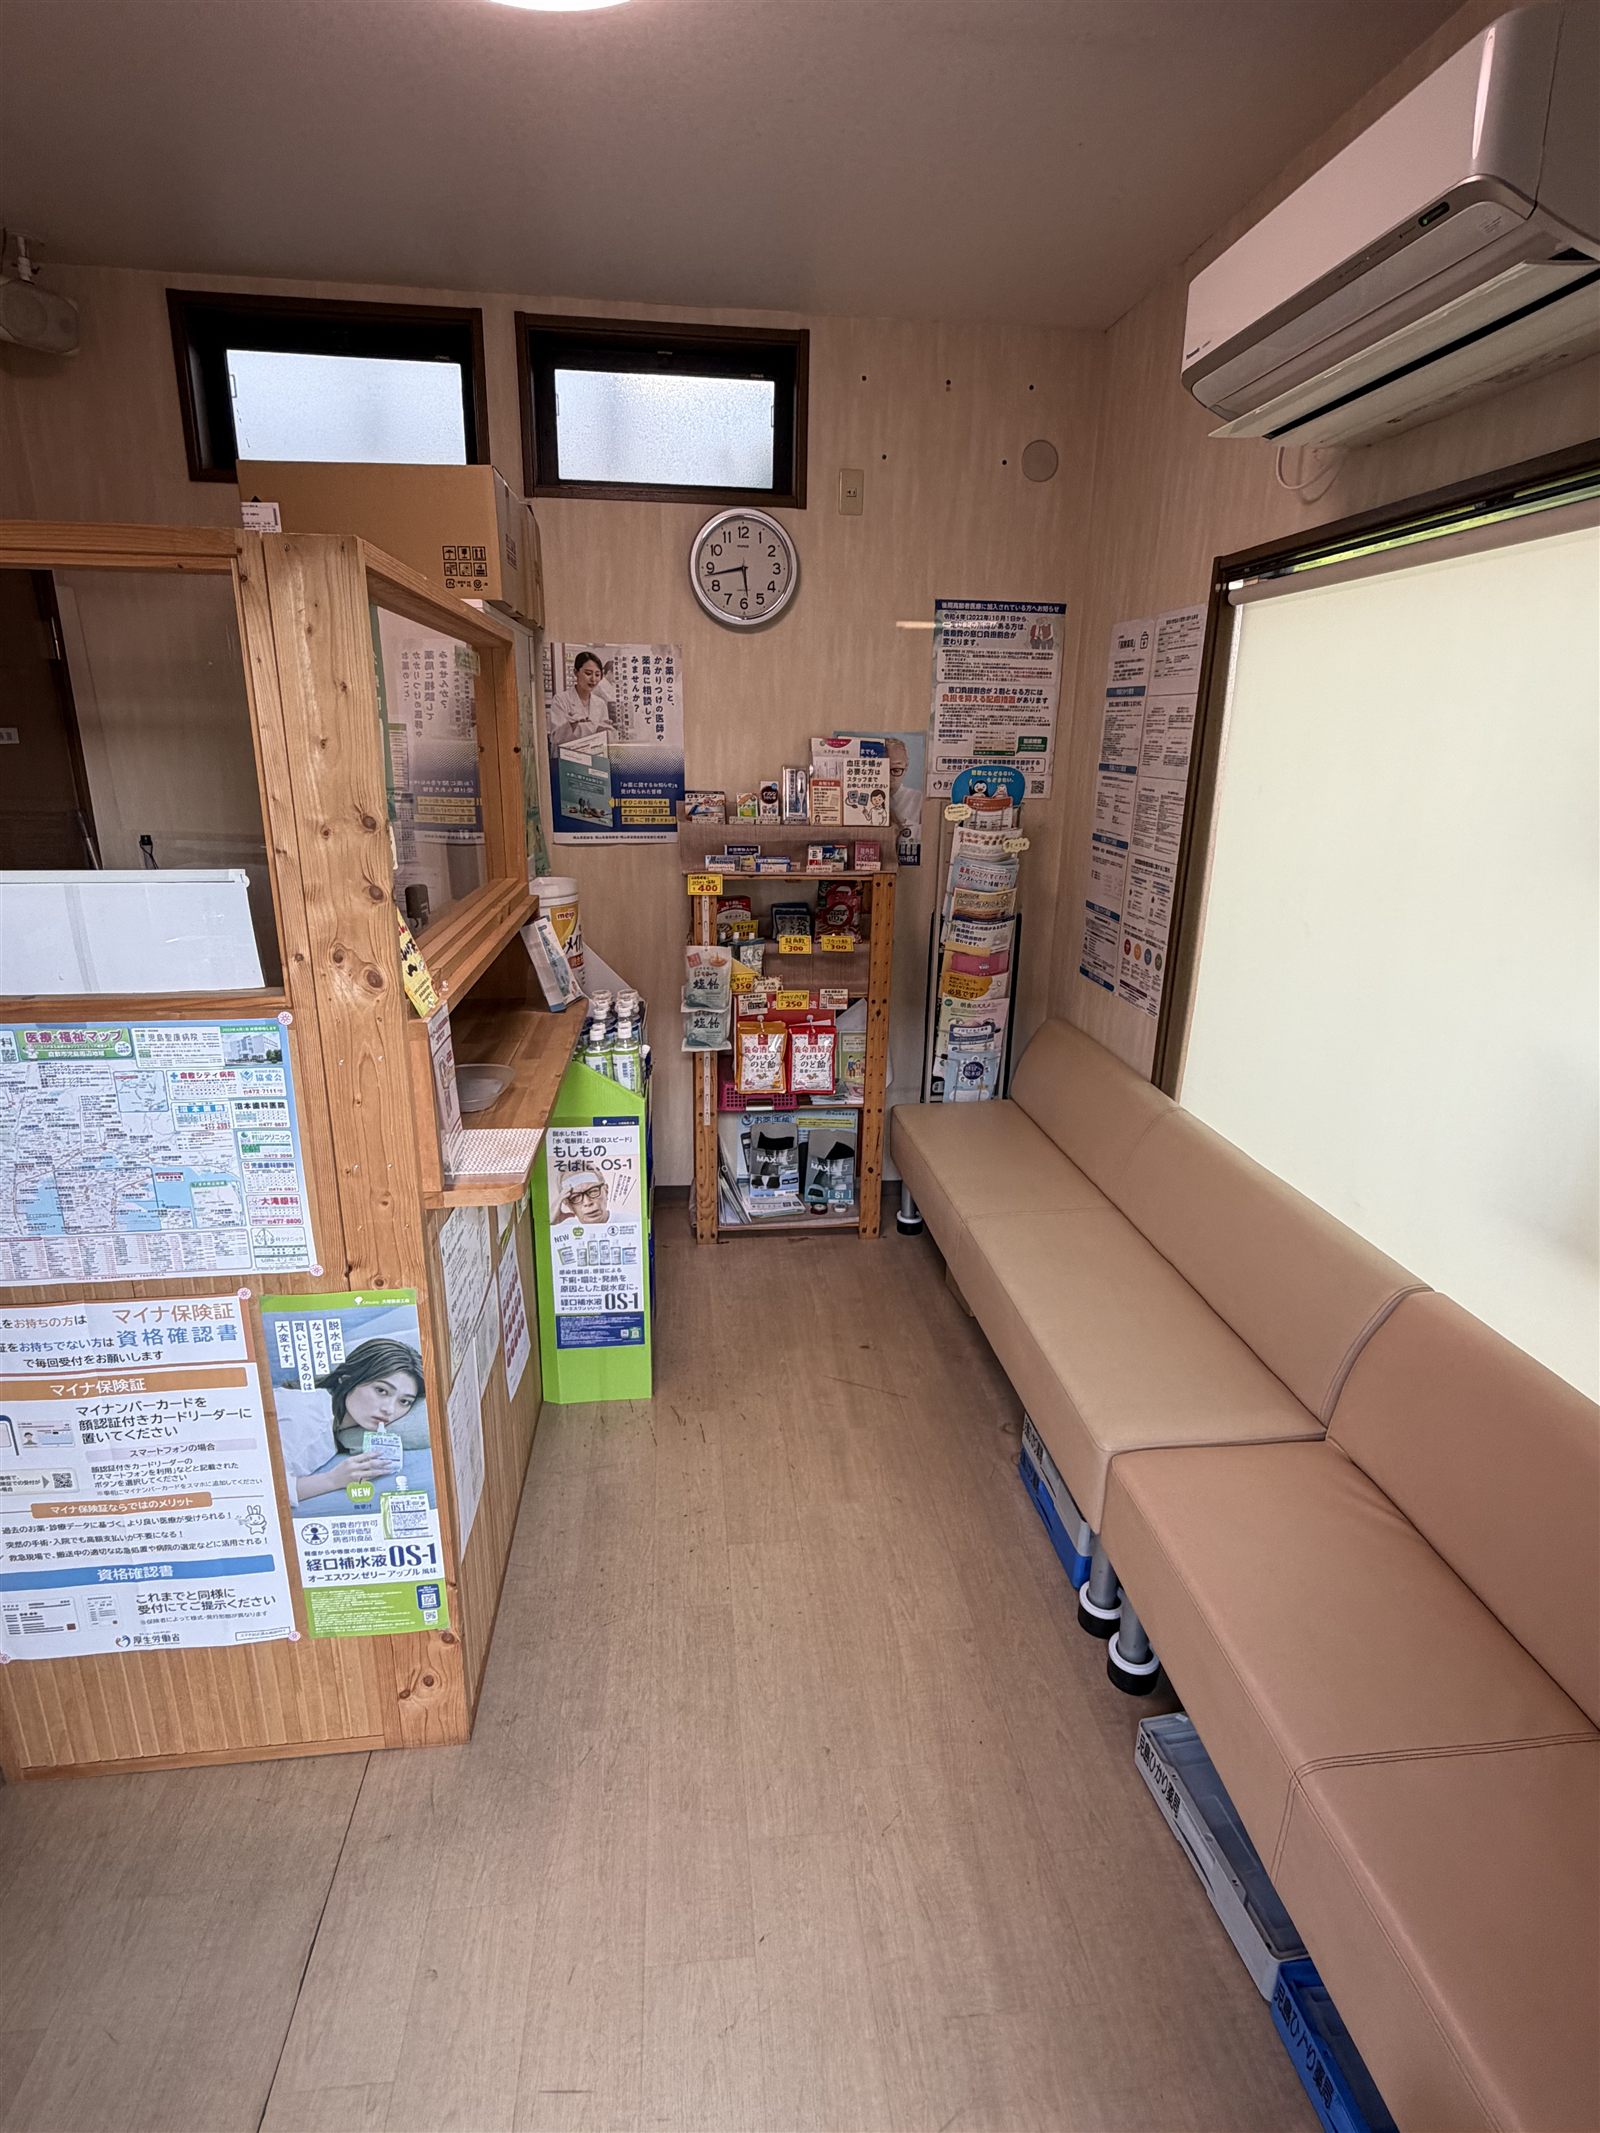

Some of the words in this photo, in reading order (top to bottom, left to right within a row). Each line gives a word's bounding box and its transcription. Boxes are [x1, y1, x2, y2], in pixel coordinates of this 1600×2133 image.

[723, 531, 732, 544] 11
[738, 526, 750, 539] 12
[758, 531, 763, 544] 1
[710, 544, 723, 557] 10
[767, 545, 776, 558] 2
[706, 562, 715, 574] 9
[772, 563, 781, 575] 3
[711, 579, 721, 592] 8
[767, 580, 776, 593] 4
[724, 593, 733, 605] 7
[739, 597, 749, 610] 6
[756, 593, 765, 605] 5
[631, 656, 640, 713] みませんか？
[665, 656, 675, 707] お薬のこと、
[641, 655, 652, 725] 薬局に相談して
[654, 656, 664, 742] かかりつけの医師や
[846, 759, 882, 767] 血圧手帳が
[846, 768, 881, 776] 必要な方は
[693, 978, 720, 990] 塩飴
[693, 1017, 721, 1029] 塩飴
[25, 1029, 123, 1044] 医療・福祉マップ
[749, 1053, 777, 1061] クロモジ
[800, 1053, 827, 1061] クロモジ
[750, 1060, 776, 1069] のど飴
[800, 1060, 826, 1069] のど飴
[552, 1145, 607, 1158] もしもの
[553, 1158, 632, 1172] そばに、OS-1
[560, 1283, 639, 1293] 原因とした脱水症に。
[561, 1297, 603, 1307] 経口補水液
[604, 1292, 639, 1310] OS-1
[0, 1314, 88, 1331] をお持ちの方は
[112, 1302, 236, 1324] マイナ保険証
[116, 1323, 239, 1349] 資格確認書
[328, 1320, 344, 1362] 脱水症に
[277, 1322, 294, 1367] 大変です。
[312, 1321, 329, 1374] なってから、
[23, 1350, 164, 1369] で毎回受付をお願いします
[294, 1321, 313, 1391] 買いにくるのは
[50, 1377, 147, 1397] マイナ保険証
[75, 1397, 208, 1417] マイナンバーカードを
[78, 1407, 253, 1431] 顔認証付きカードリーダーに
[82, 1426, 179, 1445] 置いてください
[129, 1442, 216, 1458] スマートフォンの場合
[91, 1458, 193, 1474] 顔認証付きカードリーダーの
[92, 1462, 239, 1480] 「スマートフォンを利用」などと記載された
[94, 1474, 188, 1489] ボタンを選択してください
[351, 1487, 371, 1498] NEW
[50, 1496, 194, 1515] マイナ保険証ならではのメリット
[331, 1519, 378, 1529] 消費者庁許可
[332, 1528, 372, 1536] 個別評価型
[333, 1535, 373, 1543] 病者用食品
[5, 1531, 183, 1549] 突然の手術・入院でも高額支払いが不要になる！
[306, 1554, 388, 1572] 経口補水液
[388, 1543, 437, 1568] OS-1
[97, 1565, 174, 1581] 資格確認書
[135, 1587, 237, 1604] これまでと同様に
[137, 1594, 277, 1616] 受付にてご提示ください
[133, 1633, 181, 1645] 厚生労働省
